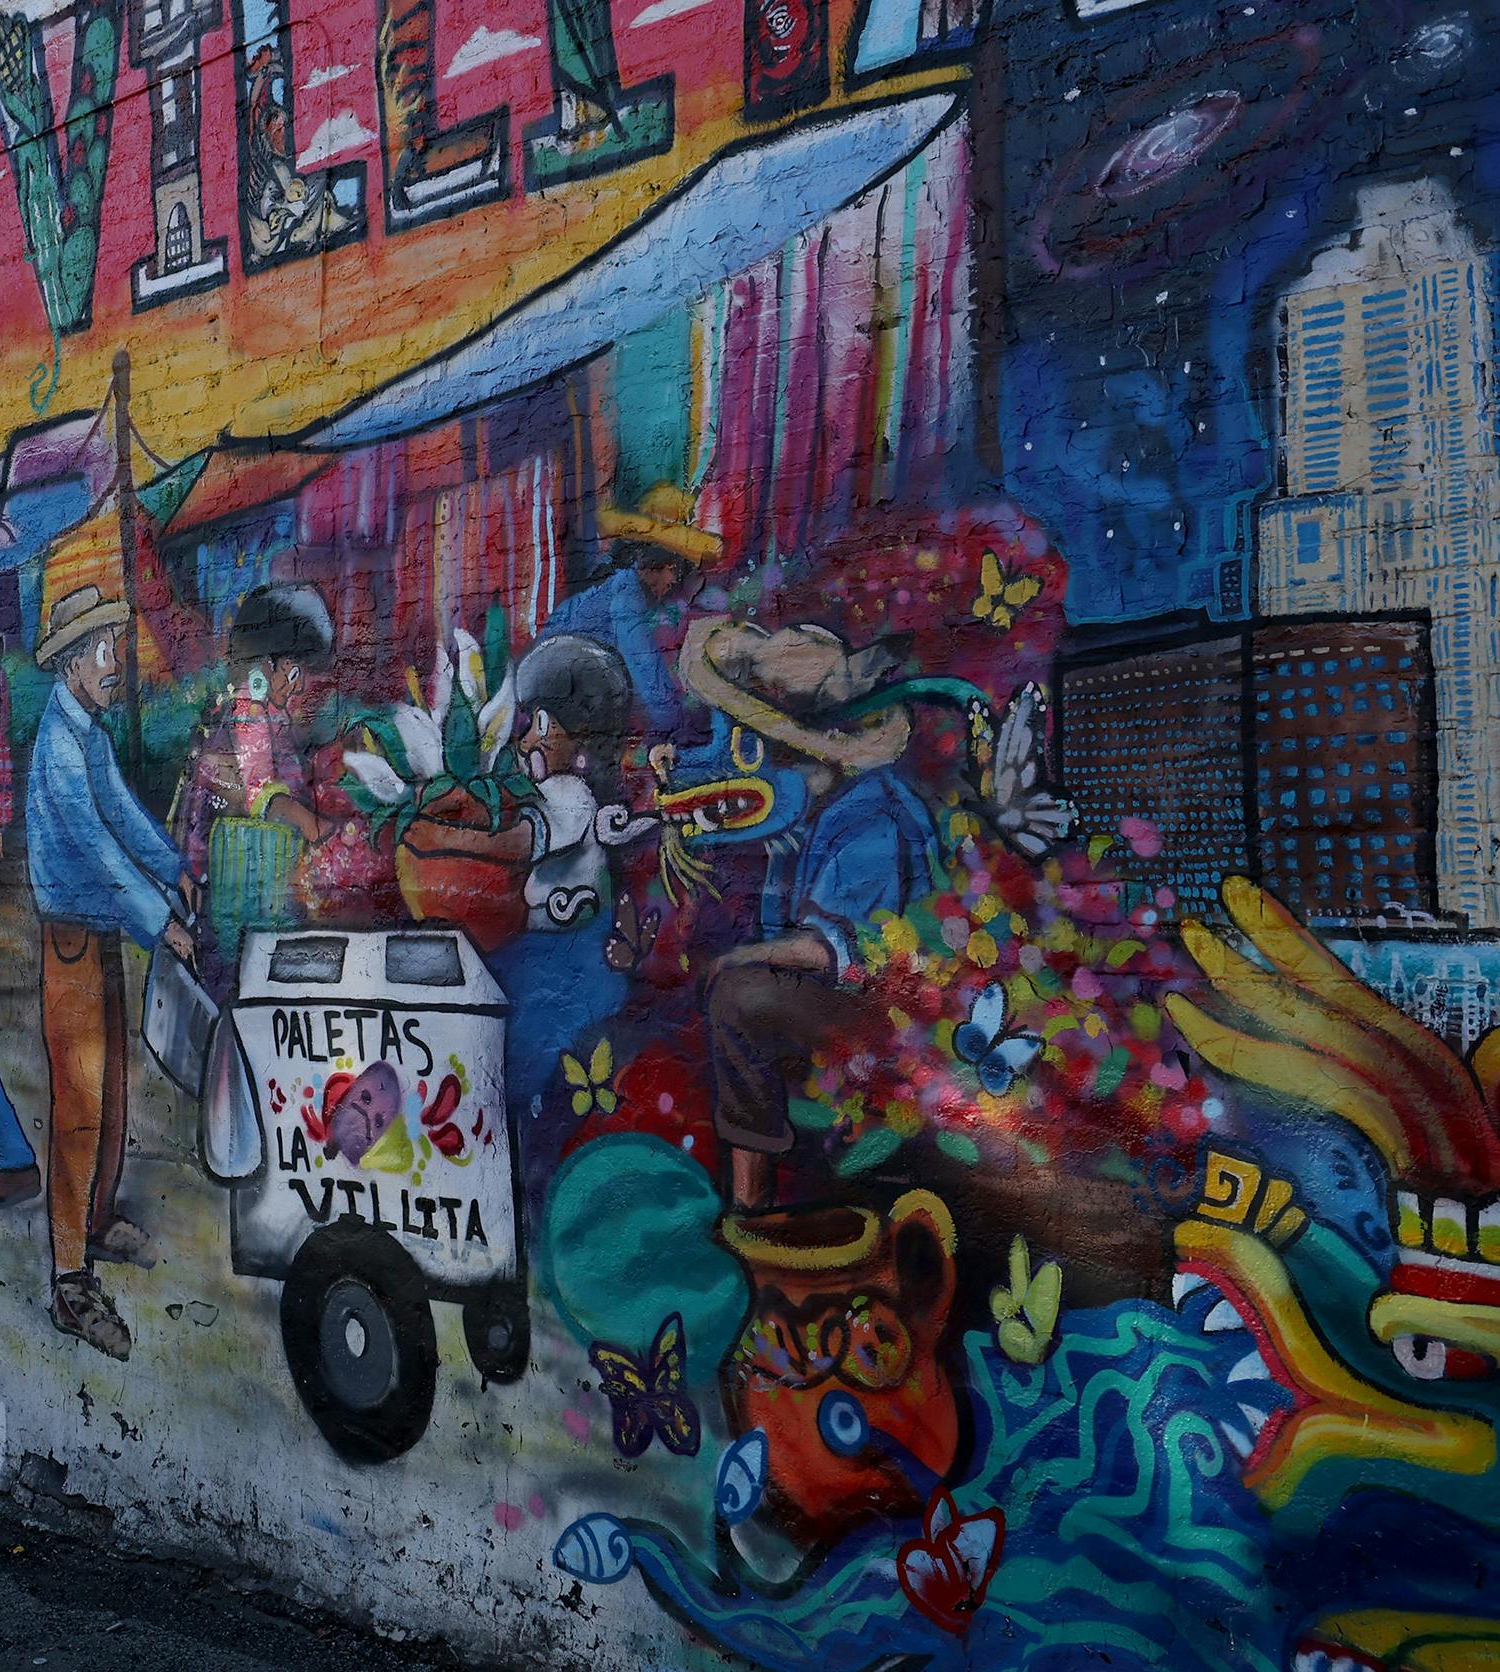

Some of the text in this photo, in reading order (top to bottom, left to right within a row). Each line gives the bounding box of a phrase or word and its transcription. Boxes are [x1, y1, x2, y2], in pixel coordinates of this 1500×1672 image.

[272, 1008, 435, 1077] PALETAS
[276, 1126, 311, 1172] LA
[288, 1177, 489, 1247] VILLITA
